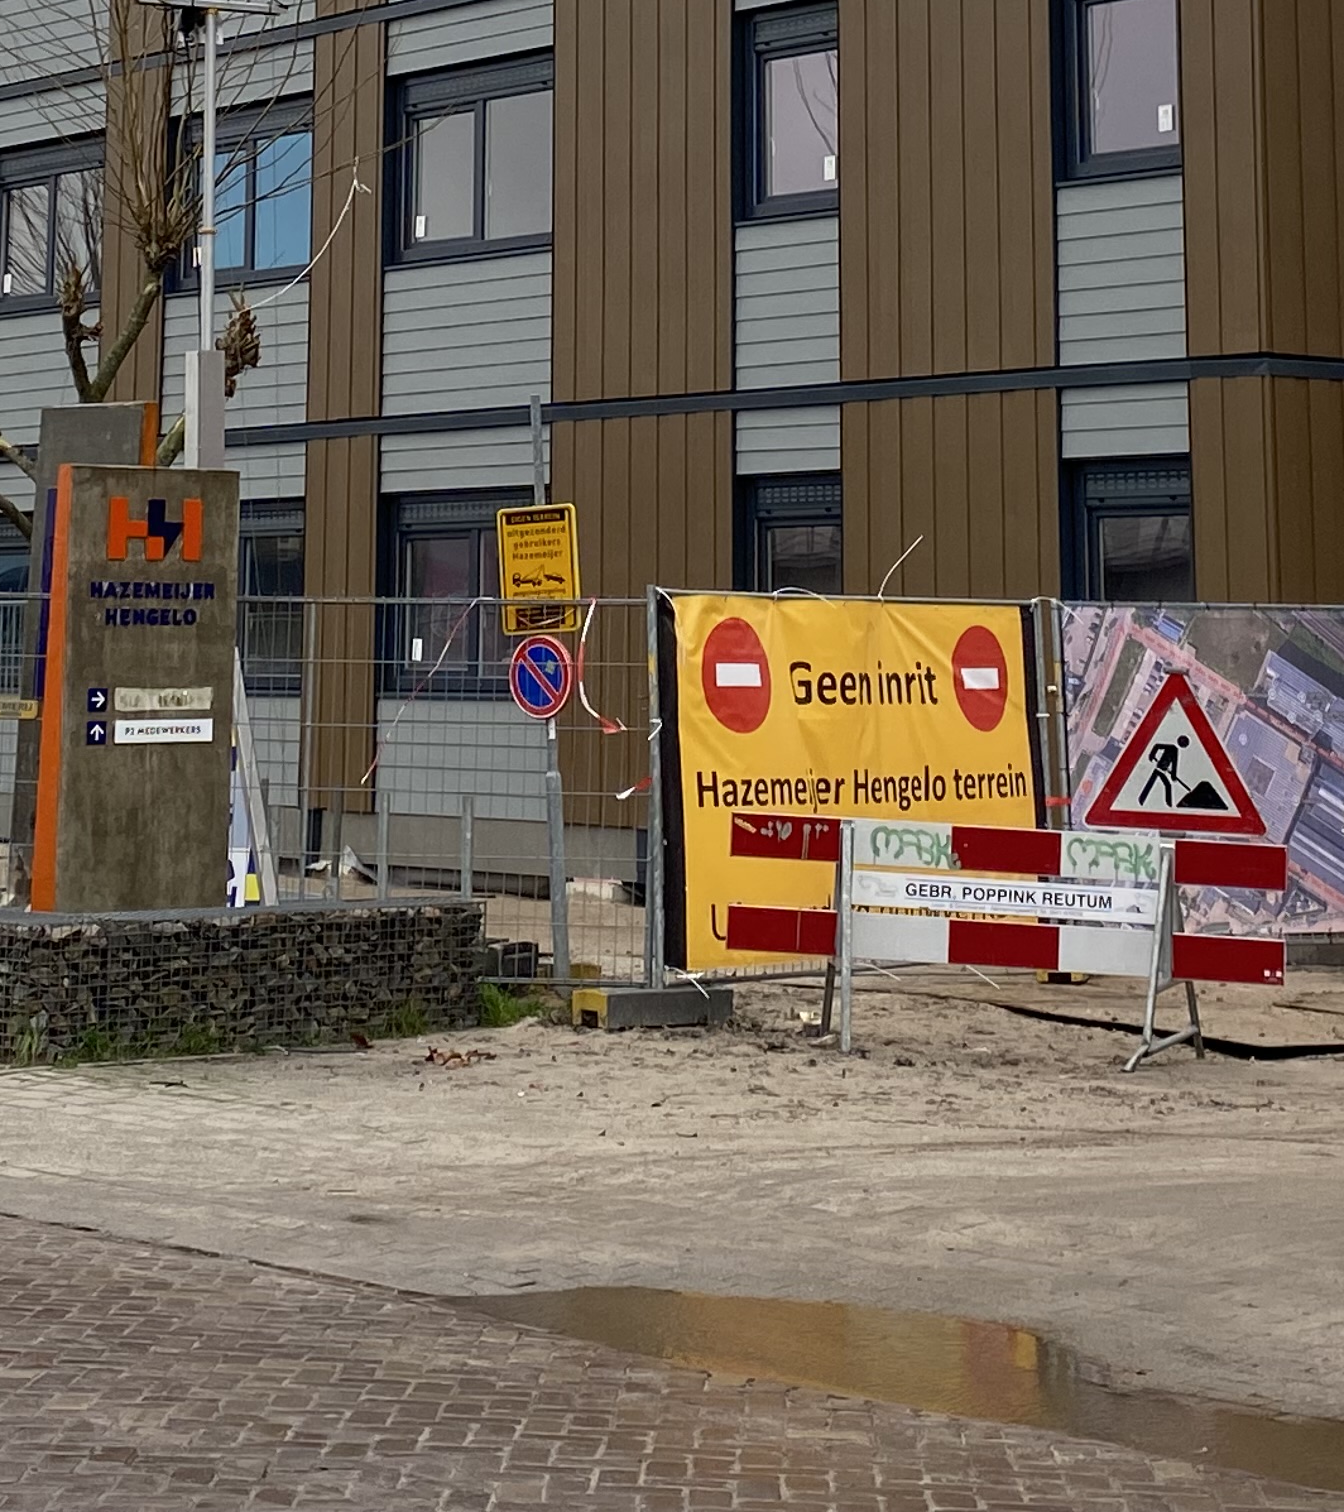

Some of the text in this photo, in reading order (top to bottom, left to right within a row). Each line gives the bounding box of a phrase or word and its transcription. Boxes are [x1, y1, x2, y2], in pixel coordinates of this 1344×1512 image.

[512, 549, 563, 561] Hazemeijer
[90, 581, 215, 600] HAZEMEIJER
[105, 608, 197, 626] HENGELO
[789, 659, 939, 706] Geen inrit
[137, 725, 202, 736] MEDEWERKERS
[696, 763, 1028, 814] Hazemeijer Hengelo terrein
[905, 882, 957, 900] GEBR.
[962, 886, 1038, 905] POPPINK
[1041, 891, 1113, 909] REUTUM
